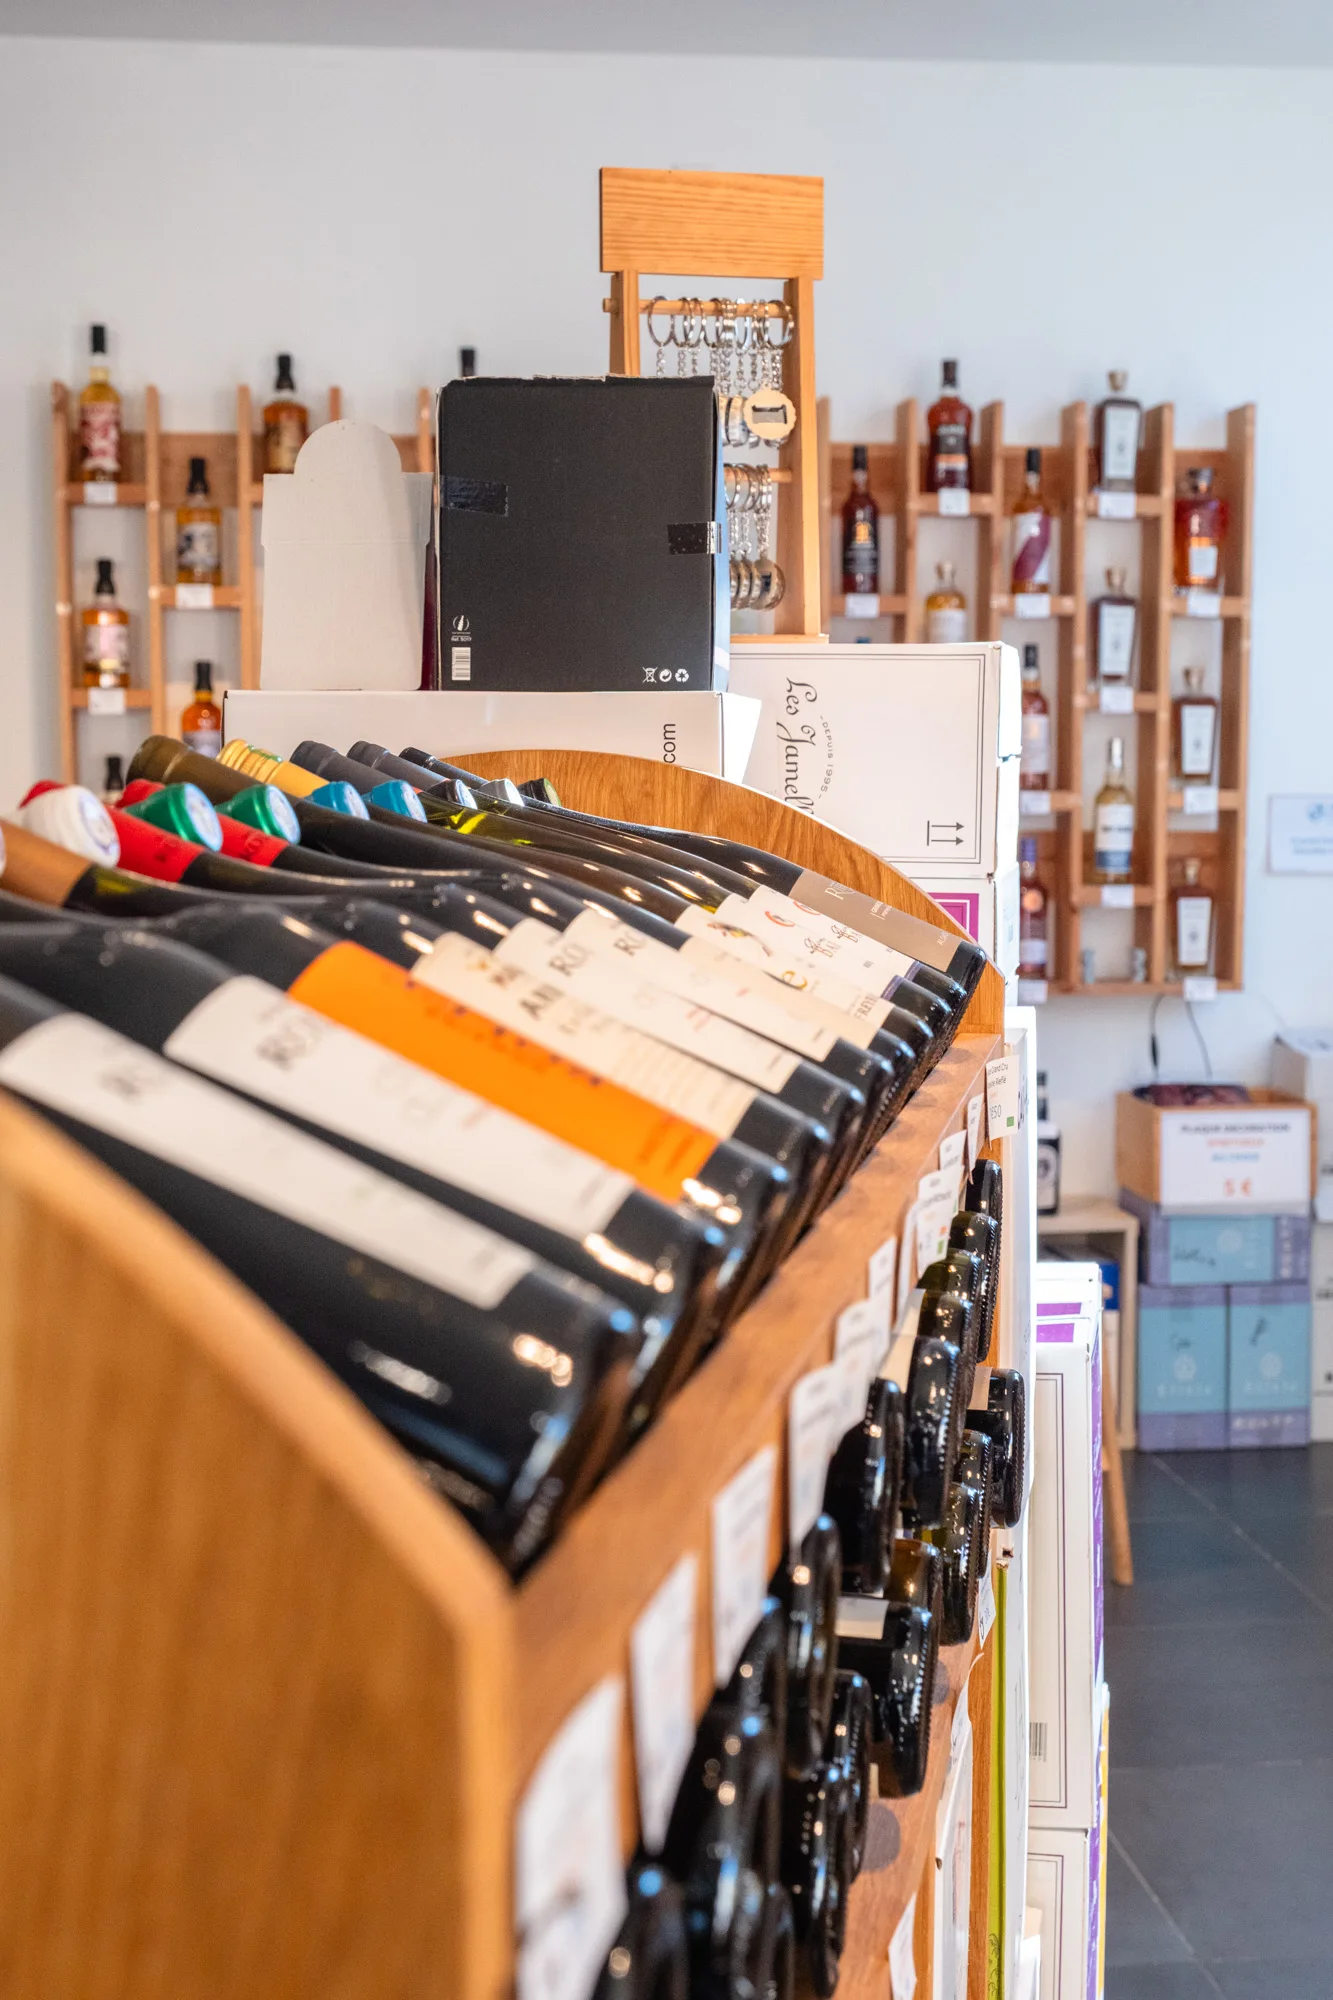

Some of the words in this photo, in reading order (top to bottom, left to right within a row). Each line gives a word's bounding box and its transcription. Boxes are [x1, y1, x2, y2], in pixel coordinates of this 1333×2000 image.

[785, 677, 818, 716] Les
[662, 722, 677, 764] com
[822, 721, 835, 760] DEPUIS
[820, 763, 835, 794] 1995
